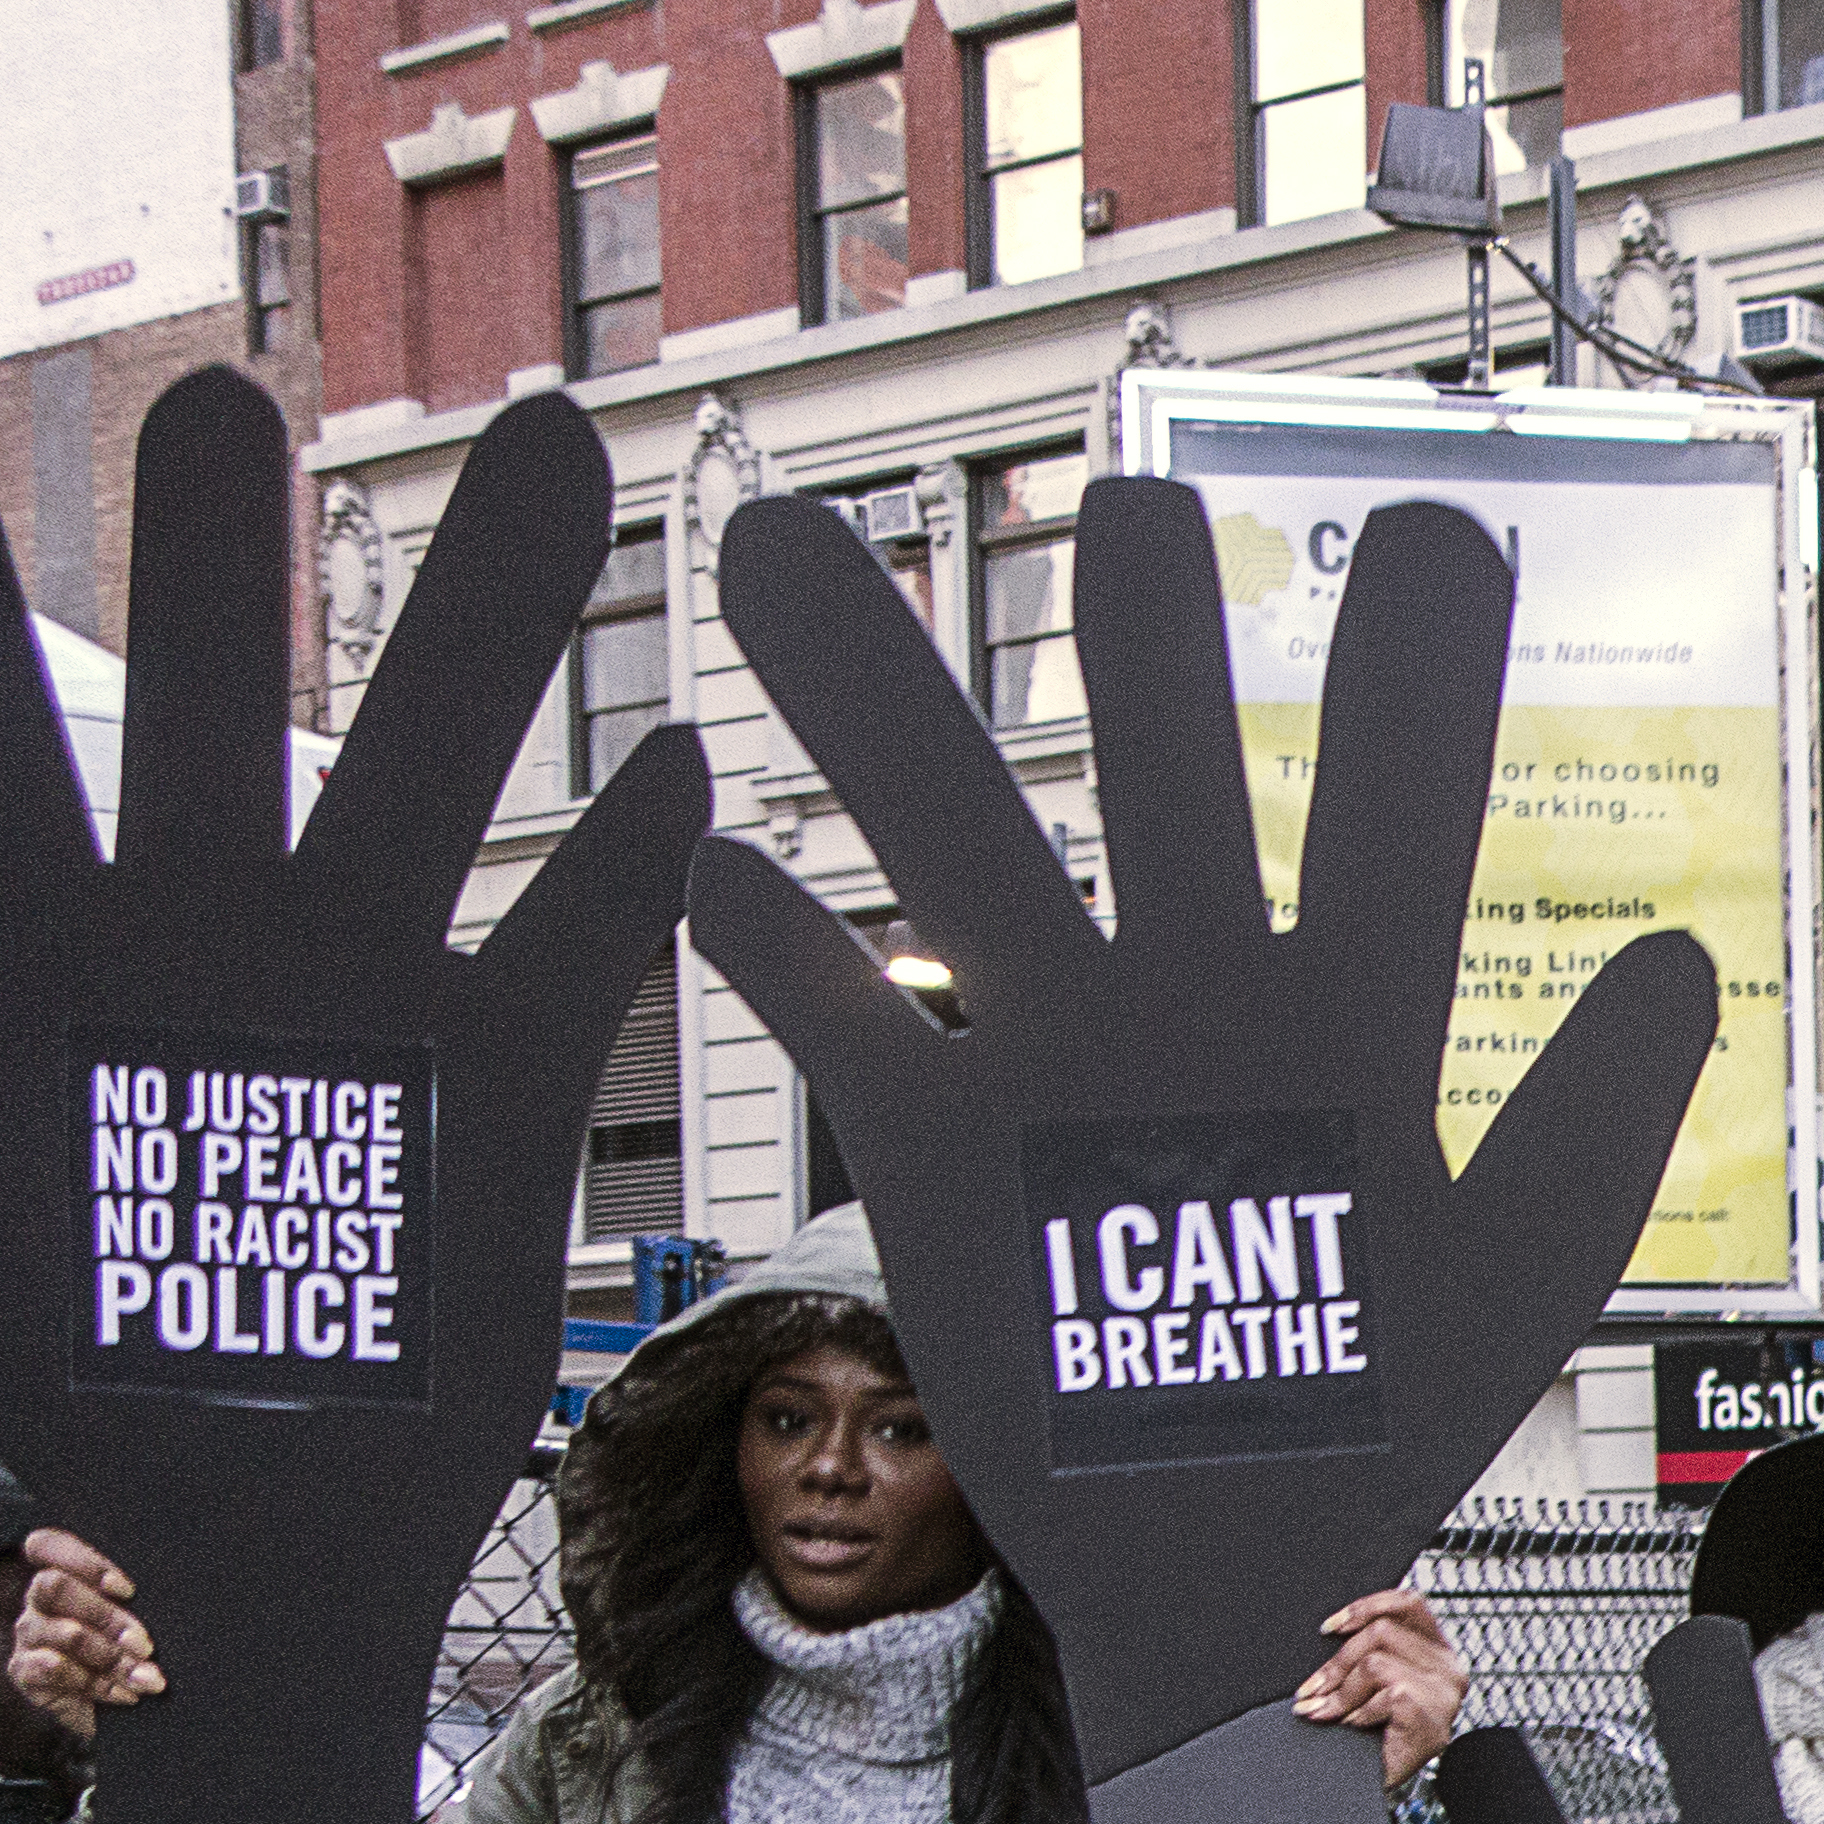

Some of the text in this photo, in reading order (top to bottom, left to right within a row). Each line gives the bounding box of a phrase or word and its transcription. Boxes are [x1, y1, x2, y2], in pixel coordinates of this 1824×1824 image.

[1555, 637, 1693, 665] Nationwide
[1554, 756, 1721, 788] choosing
[1534, 896, 1656, 923] Specials
[1460, 951, 1609, 977] king Lin
[91, 1064, 403, 1144] NO JUSTICE
[91, 1127, 403, 1211] NO PEACE
[93, 1196, 403, 1274] NO RACIST
[1044, 1191, 1353, 1317] I CANT
[96, 1262, 402, 1364] POLICE
[1050, 1300, 1367, 1393] BREATHE
